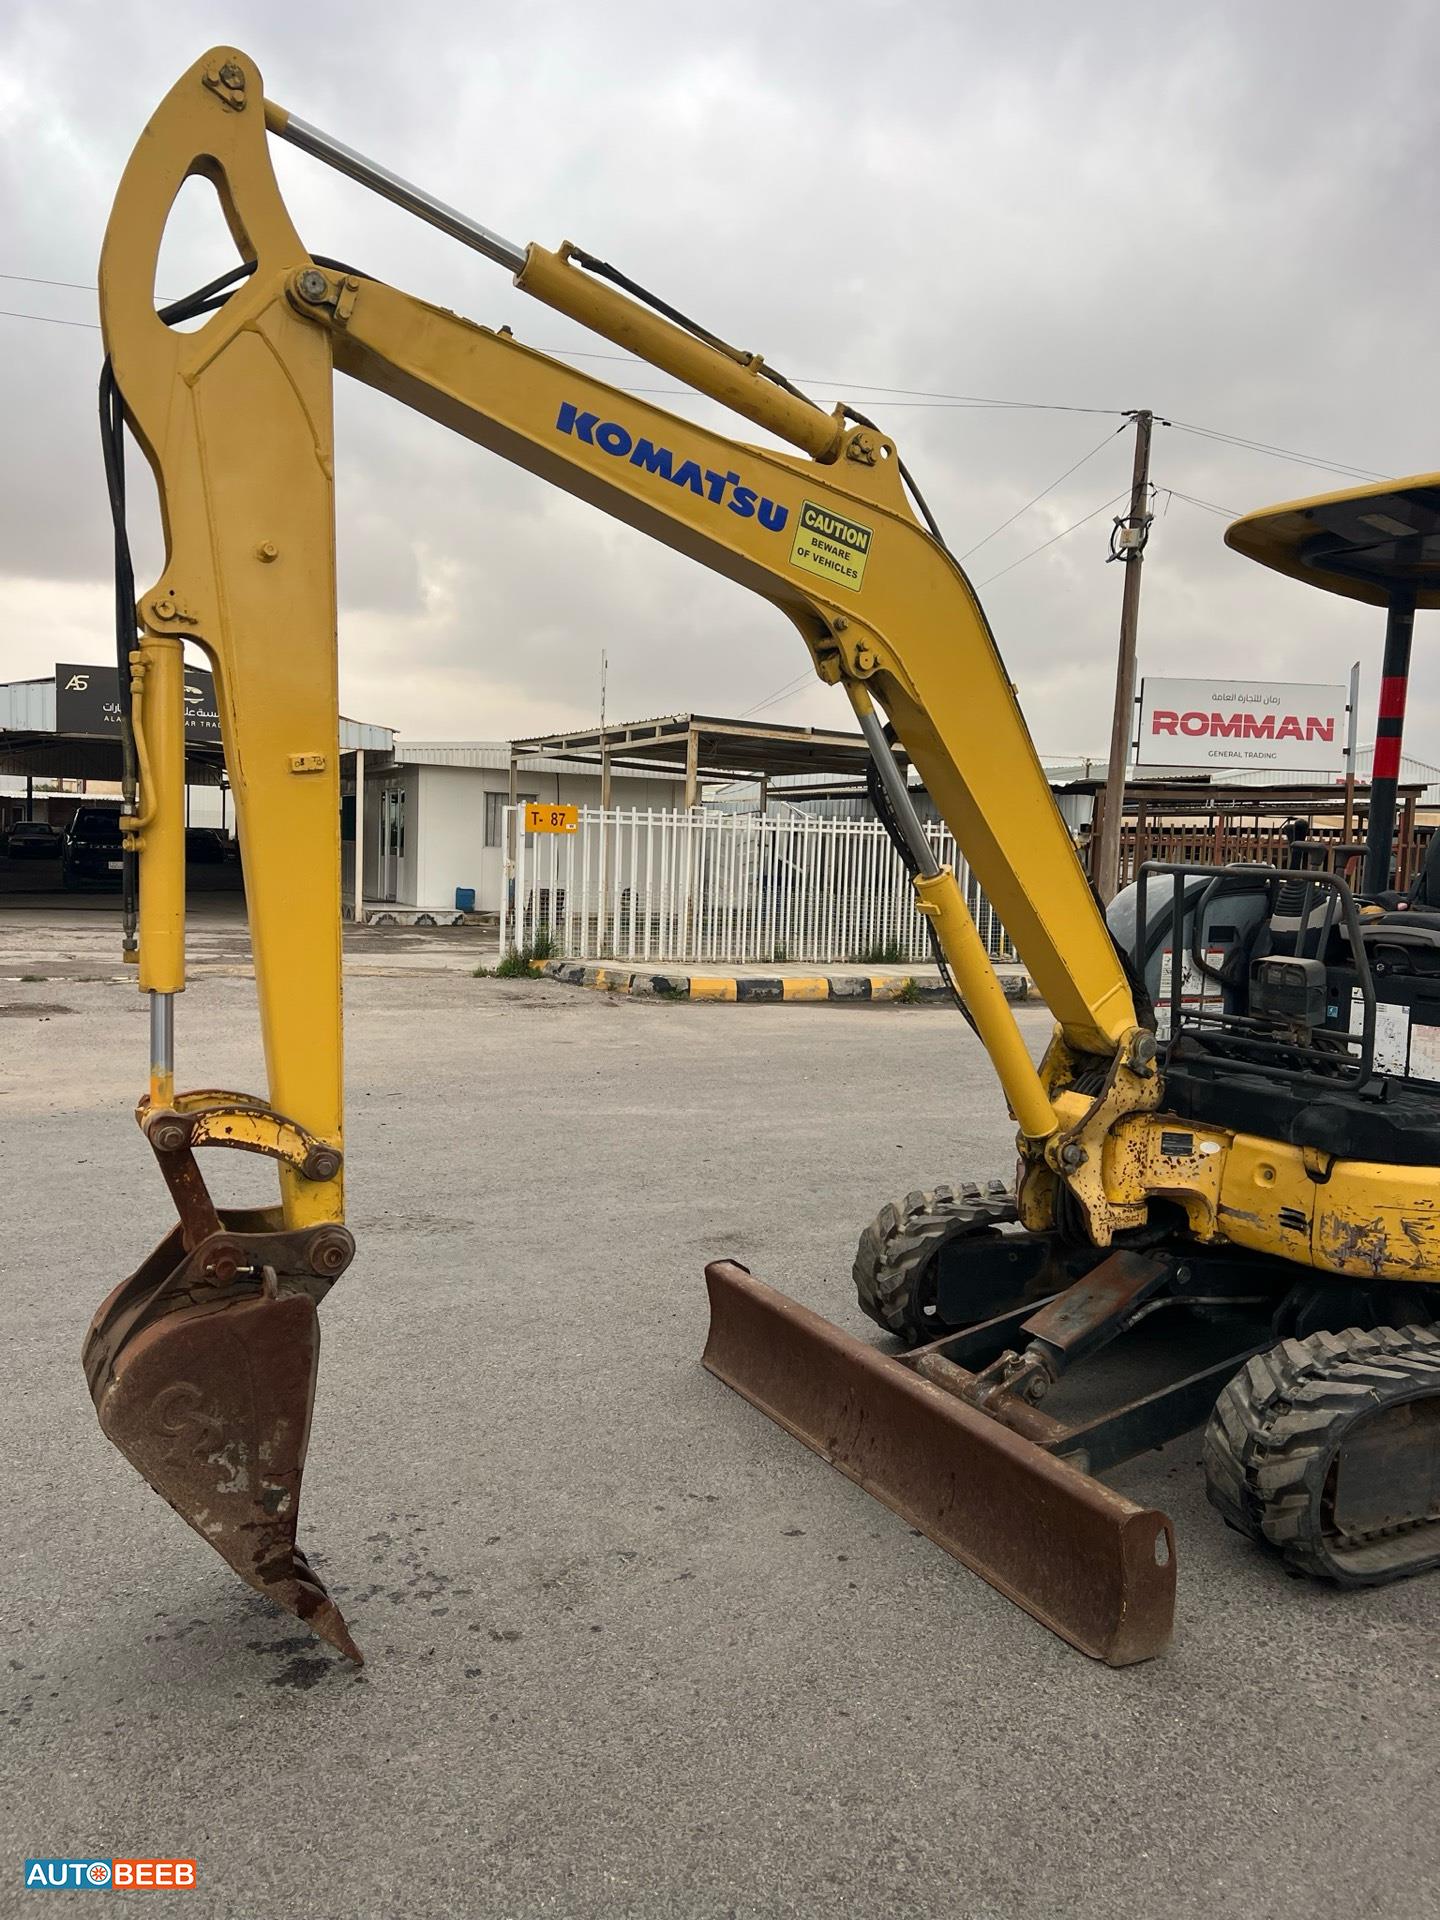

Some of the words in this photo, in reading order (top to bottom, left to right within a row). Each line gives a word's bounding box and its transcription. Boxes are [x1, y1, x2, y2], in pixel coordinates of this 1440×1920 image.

[555, 401, 790, 532] KOMATSU
[803, 508, 869, 549] CAUTION
[796, 547, 811, 558] OF
[812, 552, 859, 580] VEHICLES
[810, 537, 851, 561] BEWARE
[1152, 710, 1335, 742] ROMMAN
[1208, 750, 1243, 759] GENERAL
[1244, 751, 1277, 760] TRADING
[550, 812, 566, 827] 87
